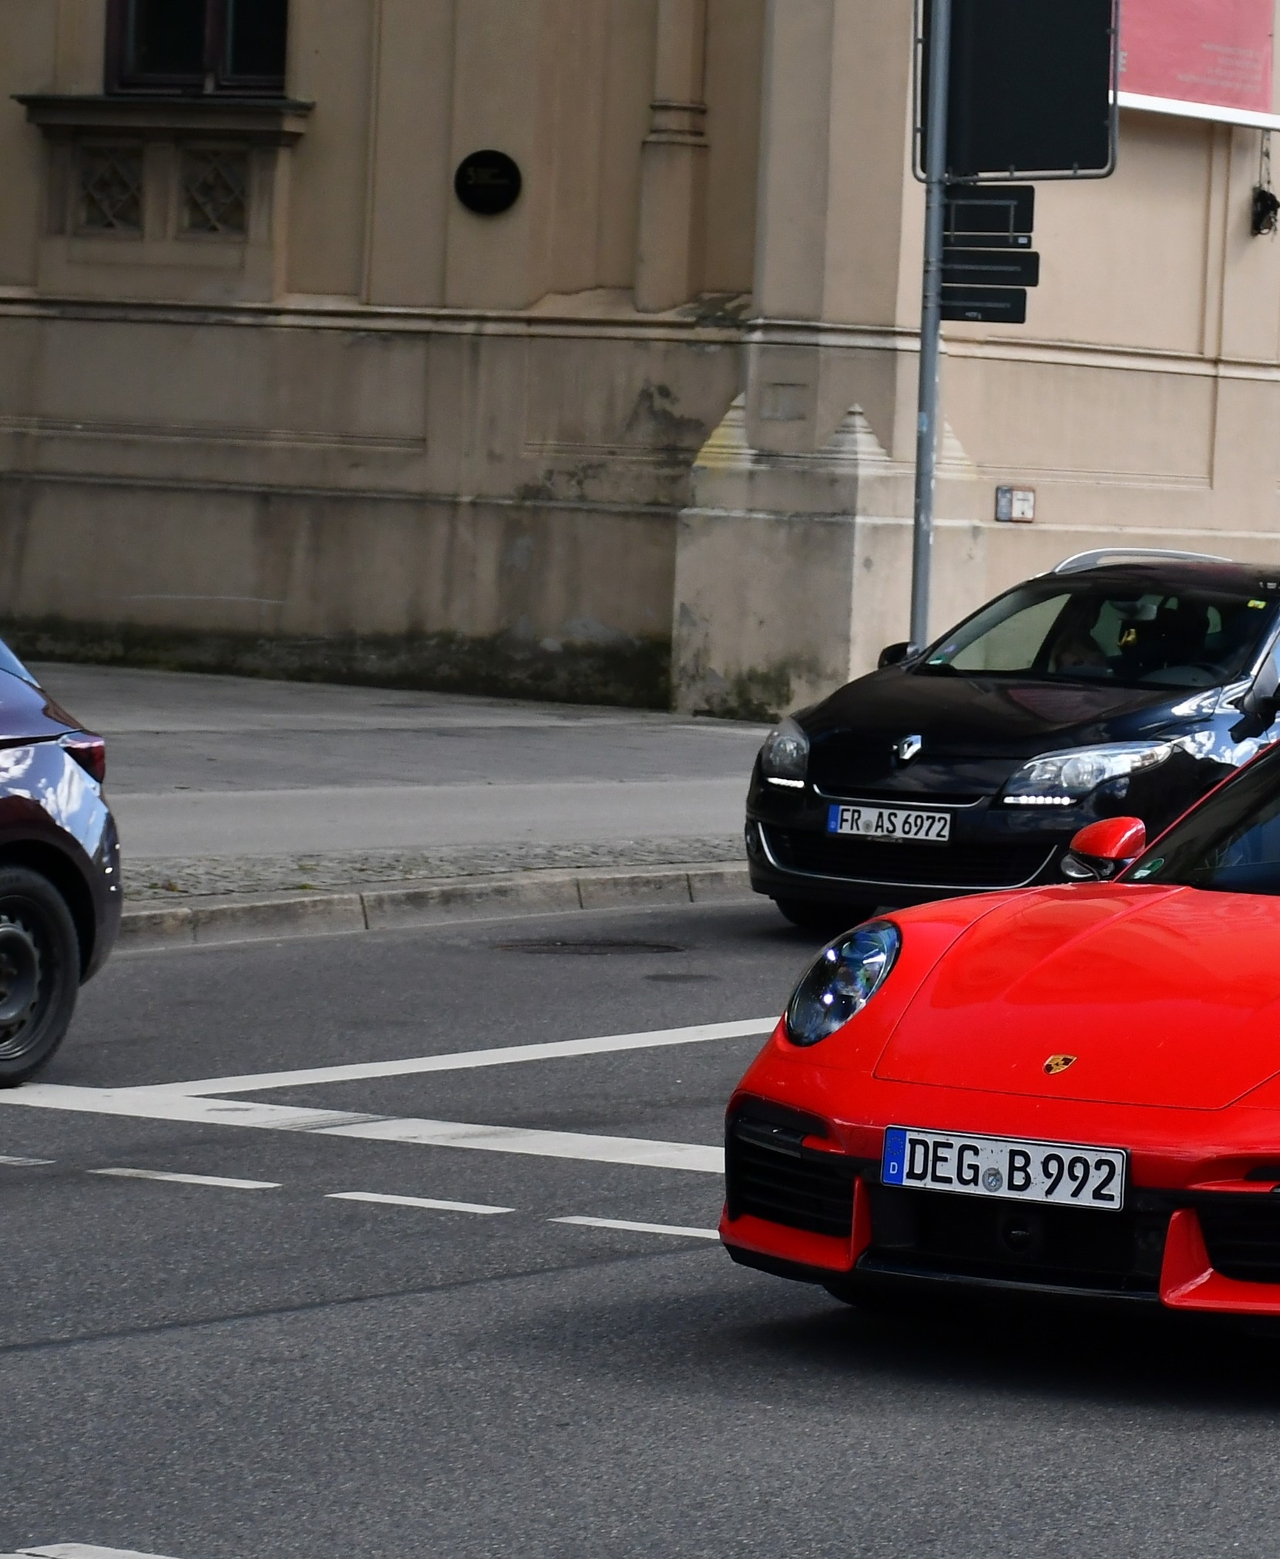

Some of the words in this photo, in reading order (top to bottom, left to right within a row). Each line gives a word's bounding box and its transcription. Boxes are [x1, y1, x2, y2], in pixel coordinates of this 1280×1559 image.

[839, 808, 862, 831] FR
[875, 811, 898, 834] AS
[902, 813, 948, 838] 6972
[889, 1161, 898, 1174] D
[906, 1138, 980, 1186] DEG
[1007, 1149, 1032, 1191] B
[1042, 1153, 1117, 1202] 992
